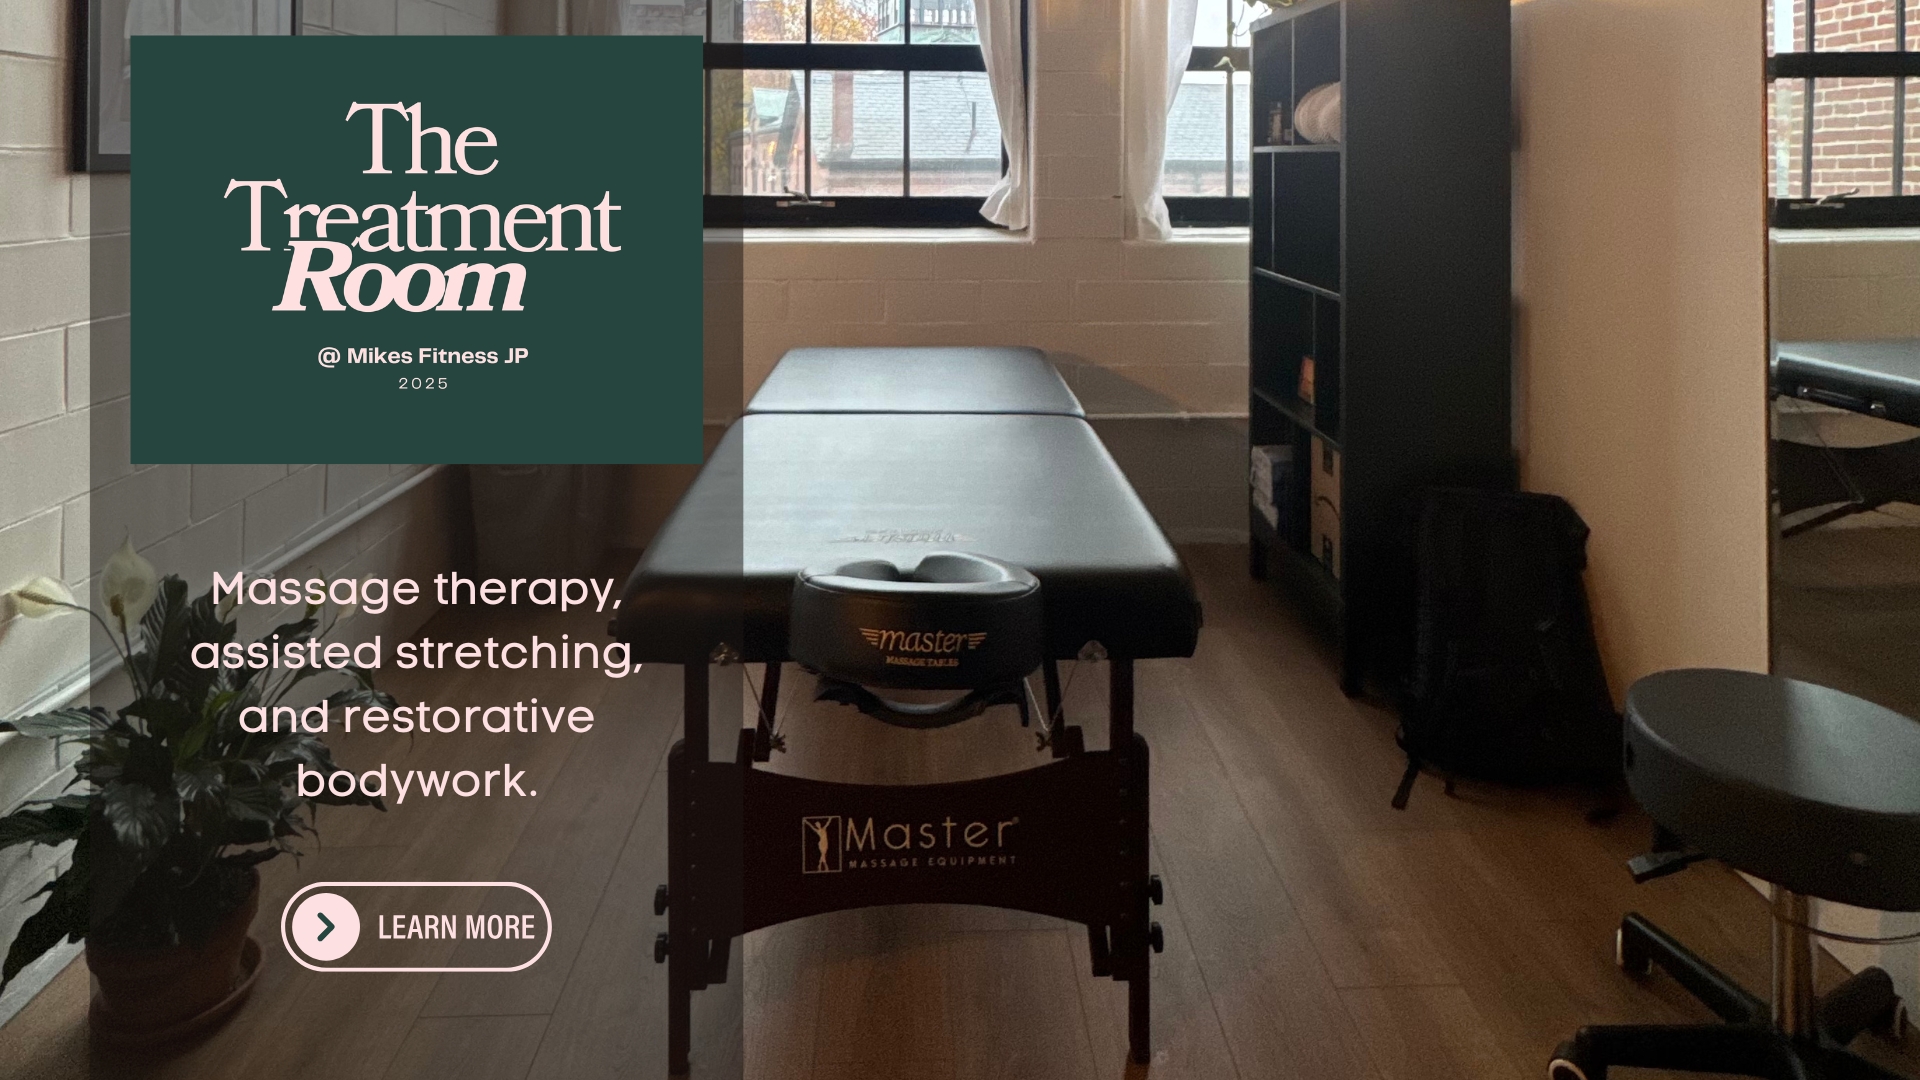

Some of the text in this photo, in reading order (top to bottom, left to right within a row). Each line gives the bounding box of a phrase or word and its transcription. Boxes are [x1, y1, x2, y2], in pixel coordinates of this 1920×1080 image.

[880, 630, 967, 653] master
[846, 816, 1014, 852] Master
[849, 855, 1017, 869] MASSAGE EQUIPMENT
